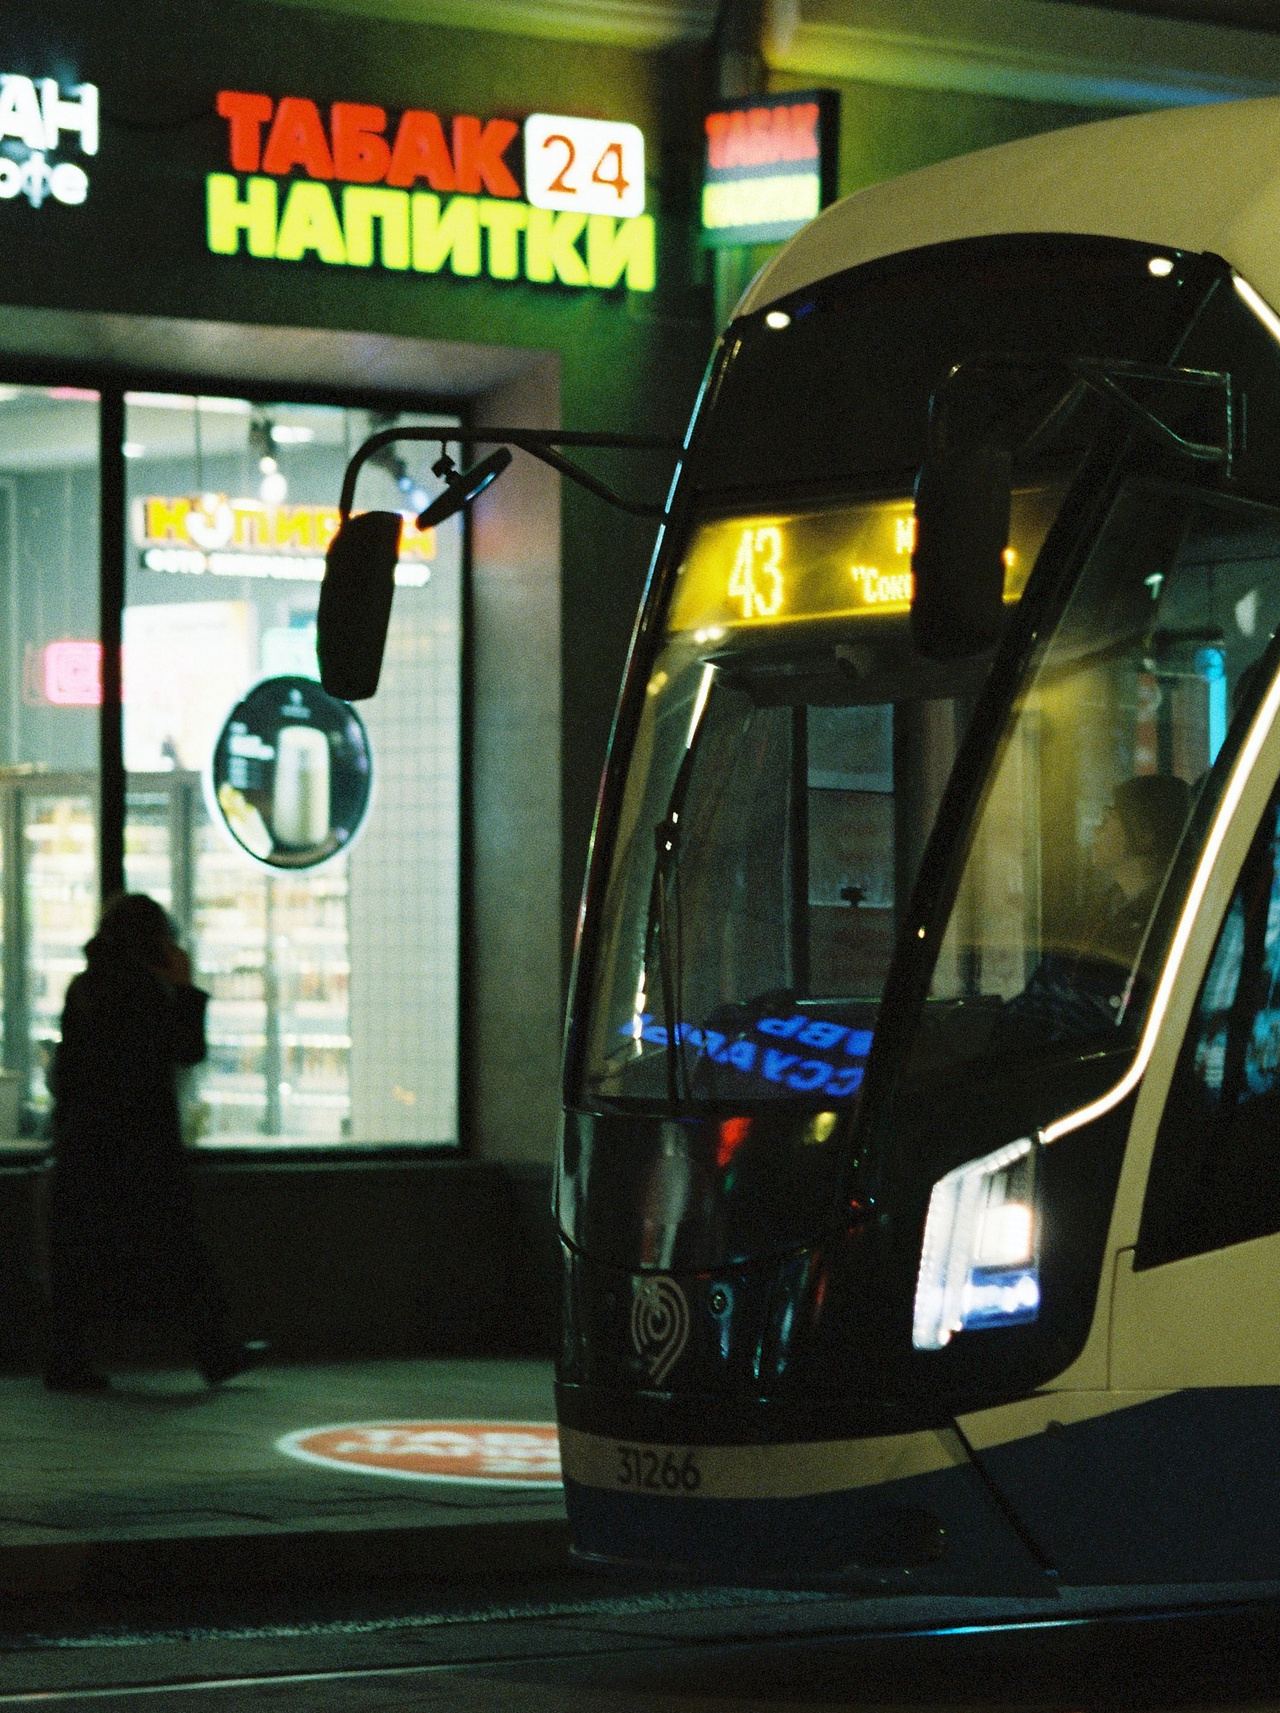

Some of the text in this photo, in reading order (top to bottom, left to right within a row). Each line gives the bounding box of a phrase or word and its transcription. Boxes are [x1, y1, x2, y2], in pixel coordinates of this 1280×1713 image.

[216, 90, 631, 200] ТАБАК 24
[206, 171, 657, 293] НАПИТКИ
[728, 526, 784, 618] 43
[618, 1446, 701, 1491] 31266
